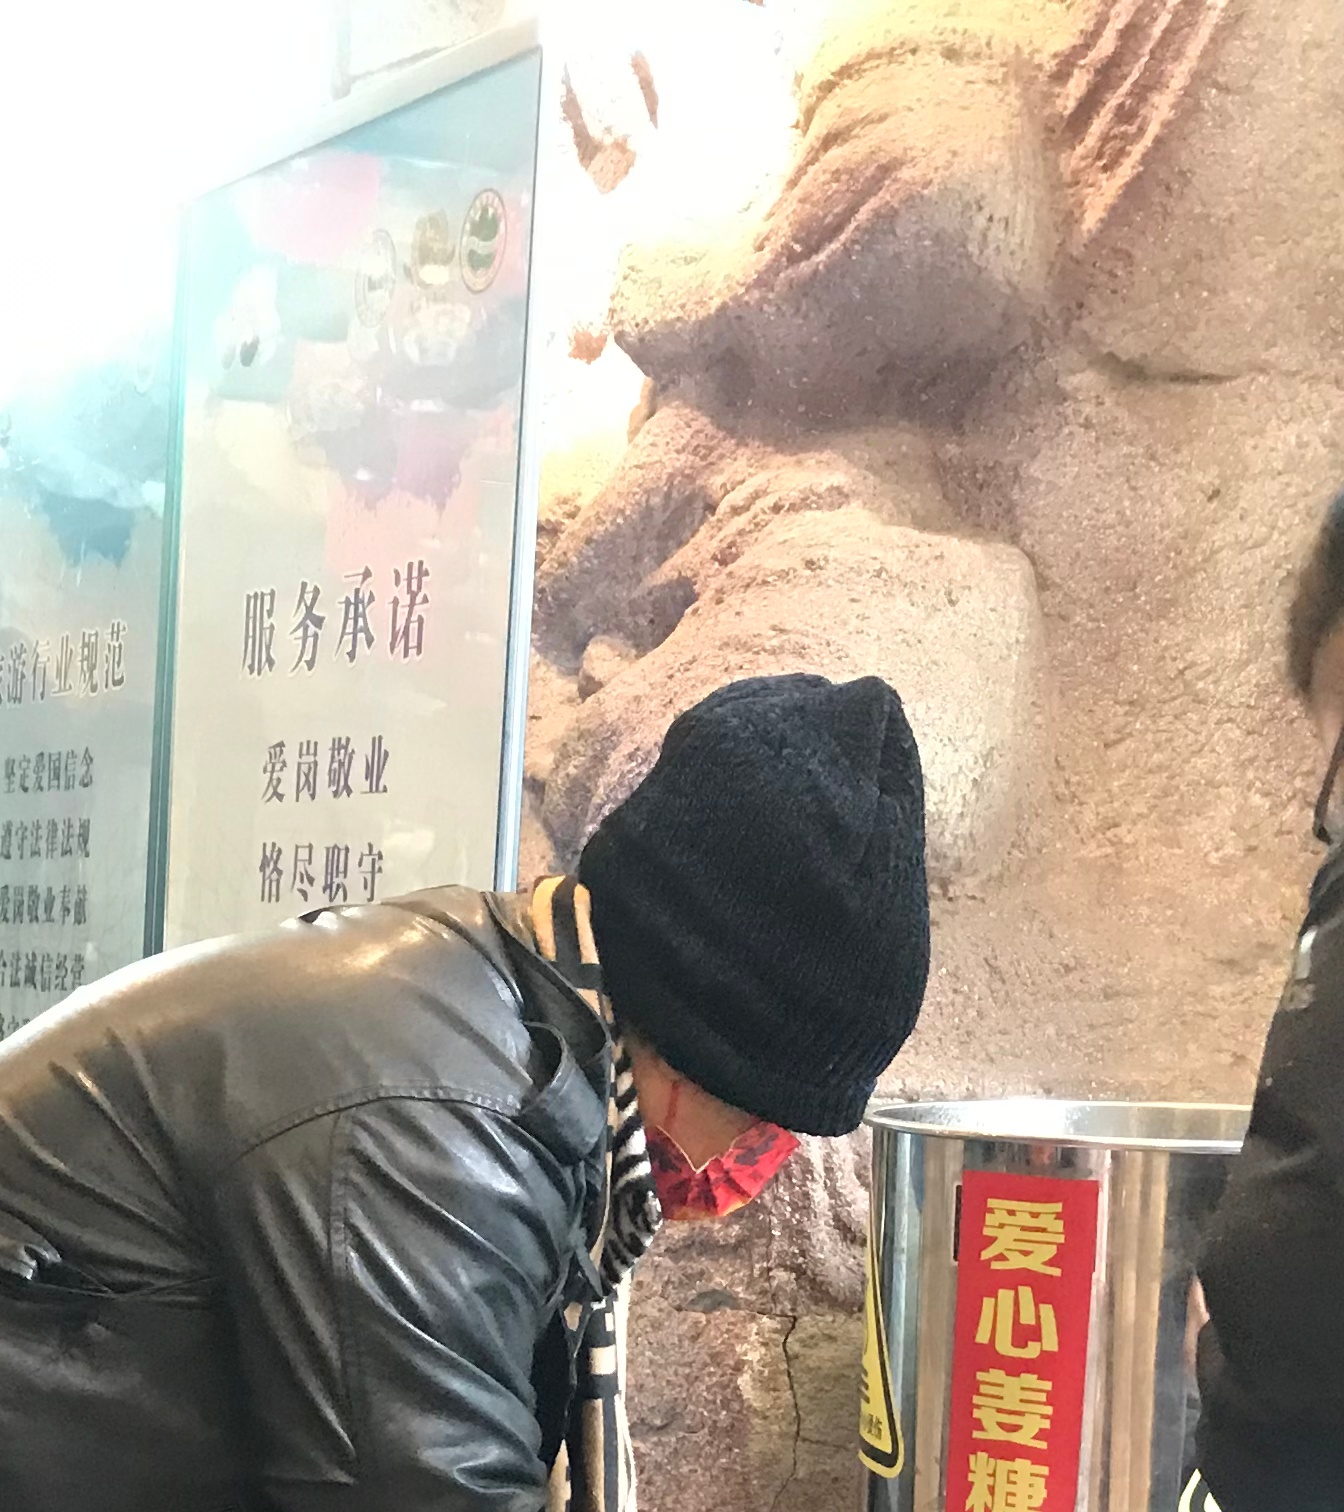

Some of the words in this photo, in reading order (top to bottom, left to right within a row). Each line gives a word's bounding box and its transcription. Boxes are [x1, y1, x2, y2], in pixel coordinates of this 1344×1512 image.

[241, 559, 430, 677] 服务承诺
[4, 746, 94, 794] 坚定爱国信念
[260, 734, 390, 804] 爱岗敬业
[0, 817, 91, 861] 遵守法律法规
[258, 841, 384, 904] 恪尽职守
